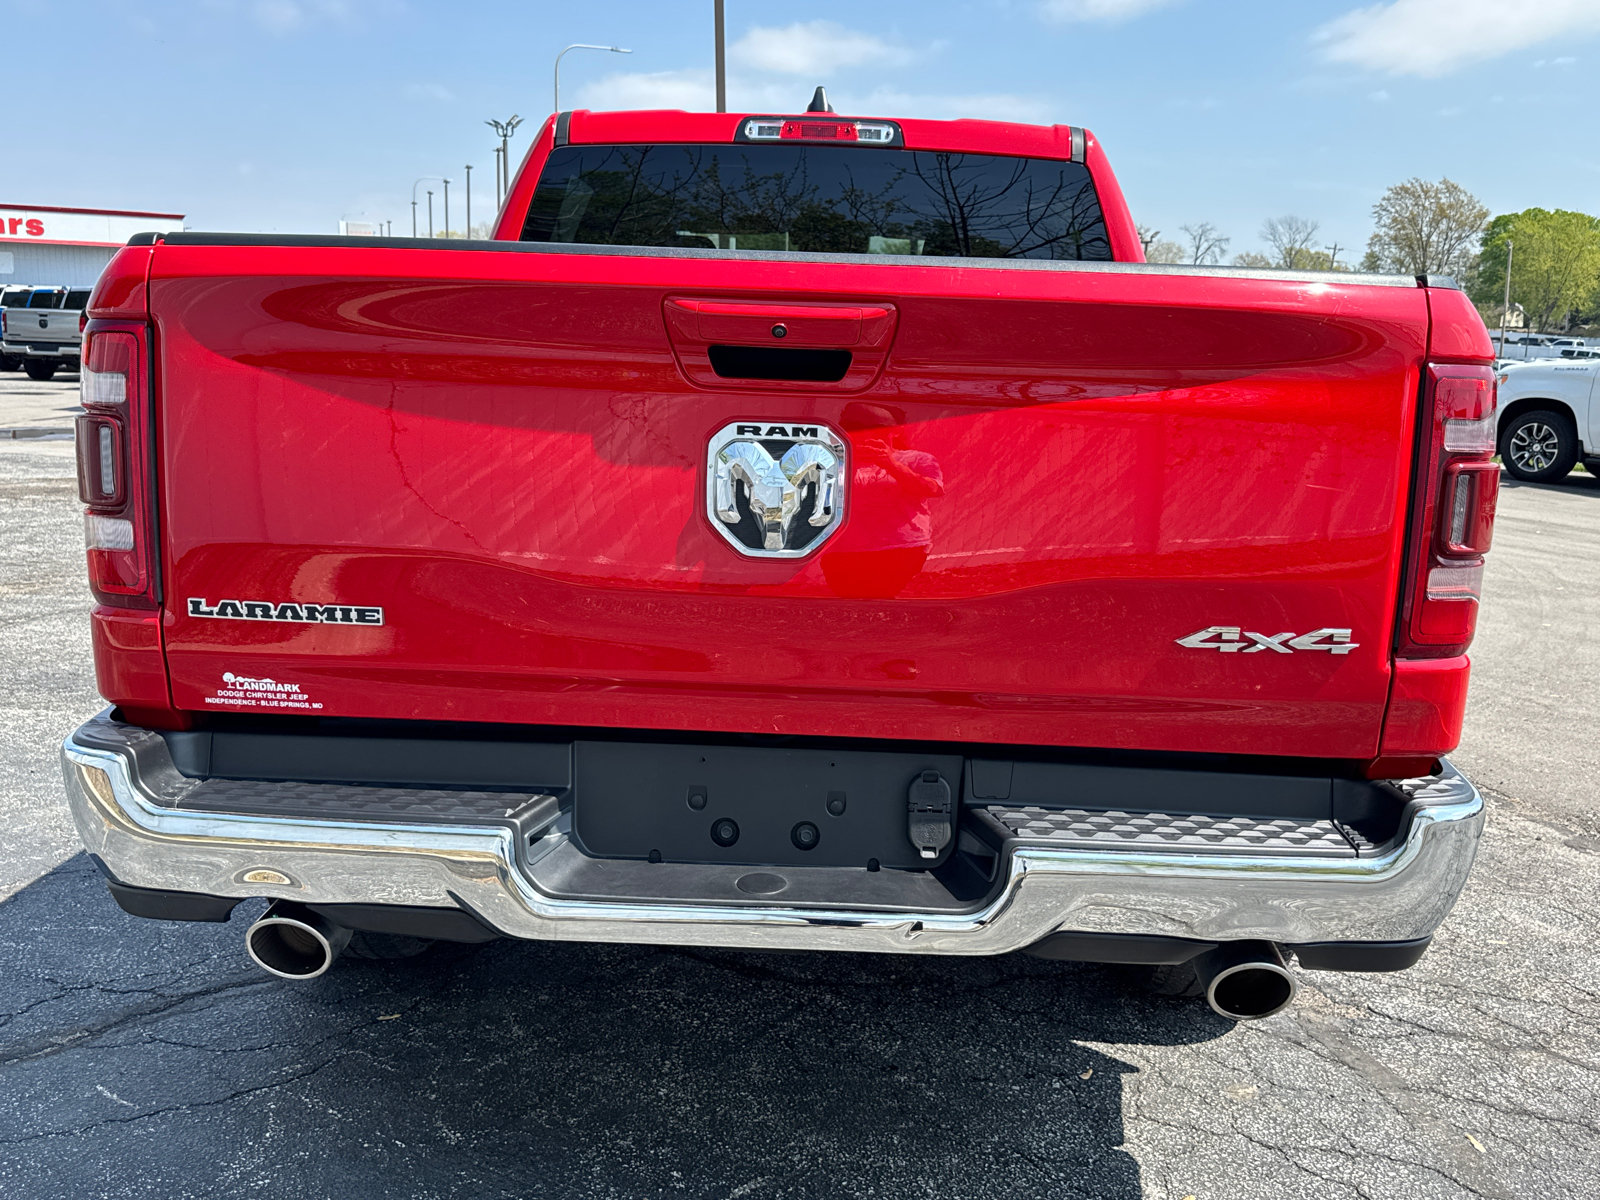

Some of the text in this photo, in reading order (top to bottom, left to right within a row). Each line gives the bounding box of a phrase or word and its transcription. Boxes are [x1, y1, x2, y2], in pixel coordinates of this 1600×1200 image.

[736, 424, 818, 438] RAM
[187, 597, 385, 626] LARAMIE
[235, 681, 301, 692] LANDMARK
[217, 689, 309, 701] DODGE CHRYSLER JEEP
[205, 697, 257, 706] INDEPENDENCE
[260, 700, 280, 708] BLUE
[279, 700, 312, 709] SPRINGS,
